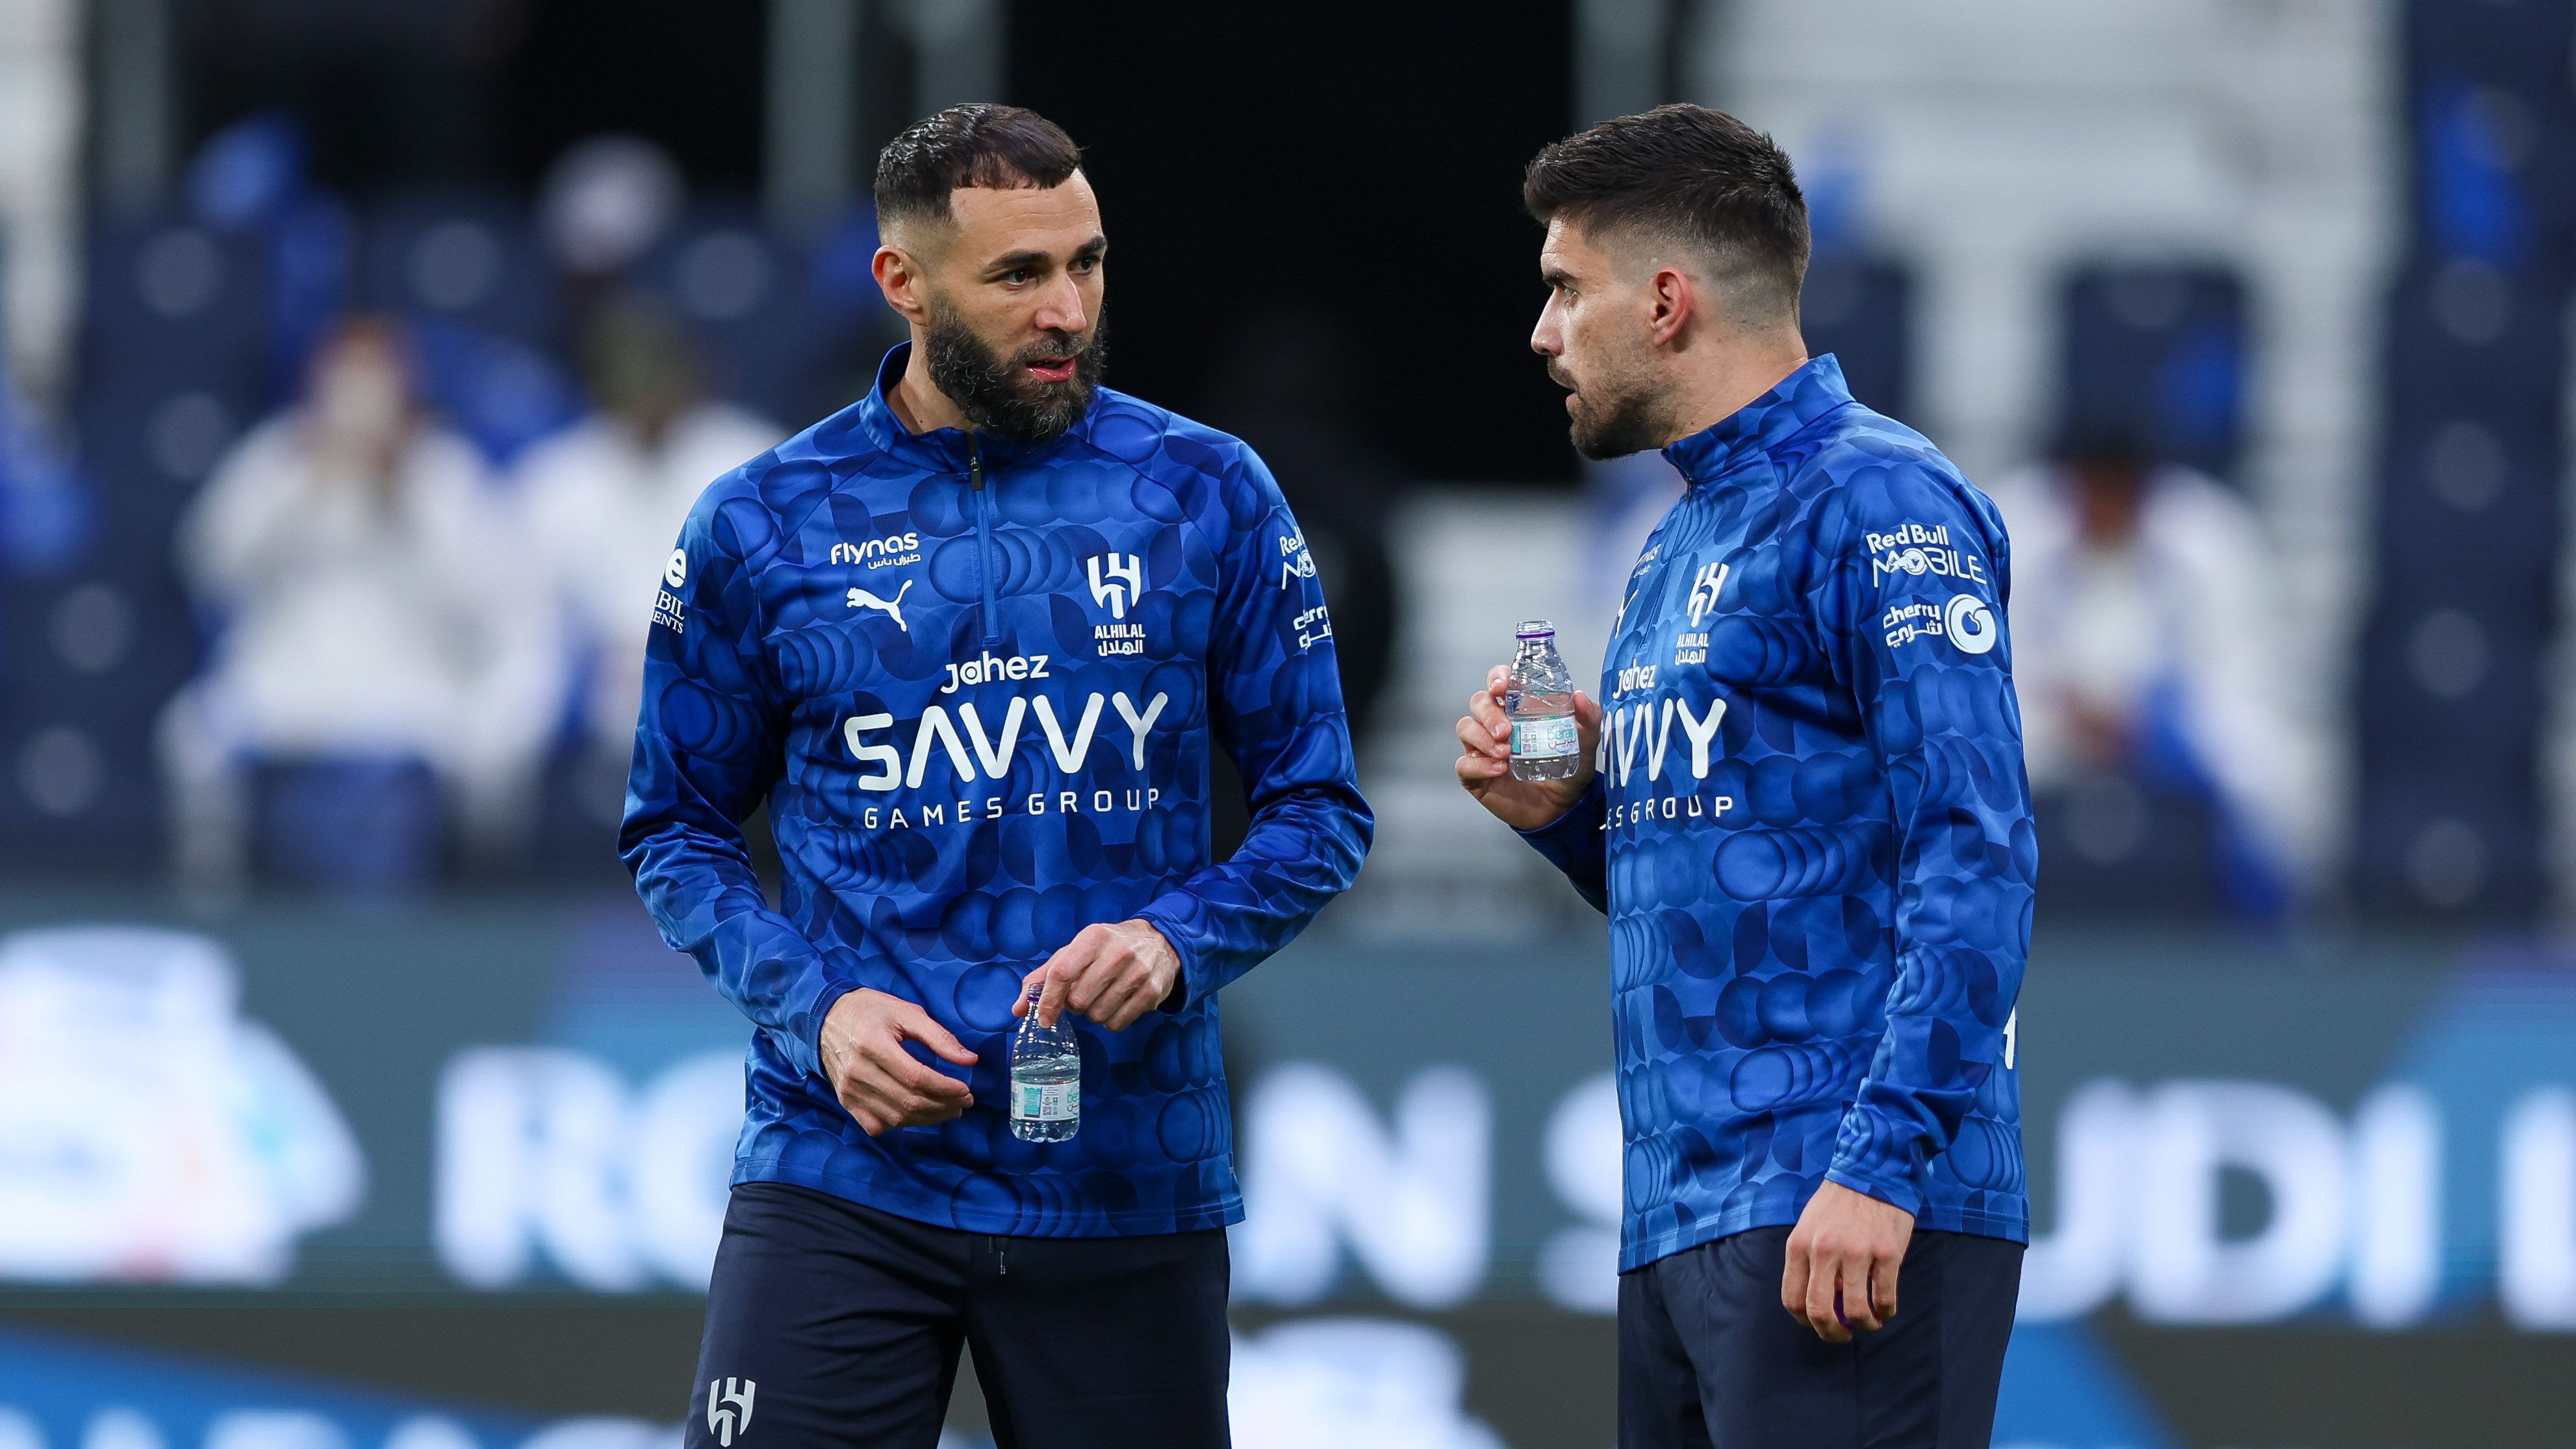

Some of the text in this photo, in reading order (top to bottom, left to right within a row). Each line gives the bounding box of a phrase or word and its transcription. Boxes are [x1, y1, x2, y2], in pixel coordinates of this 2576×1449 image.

[831, 532, 919, 565] flynas
[1866, 524, 1948, 554] Red Bull
[1872, 547, 1987, 587] MOBILE
[655, 589, 685, 621] BIL
[1883, 604, 1941, 629] cherry
[651, 610, 684, 634] ENTS
[1098, 639, 1143, 656] الهلال
[1675, 648, 1706, 666] الهلال
[941, 650, 1049, 694] jahez
[845, 691, 1168, 791] SAVVY
[1603, 697, 1727, 789] AVVY
[865, 788, 1159, 829] GAMES GROUP
[1631, 795, 1733, 824] GROUP
